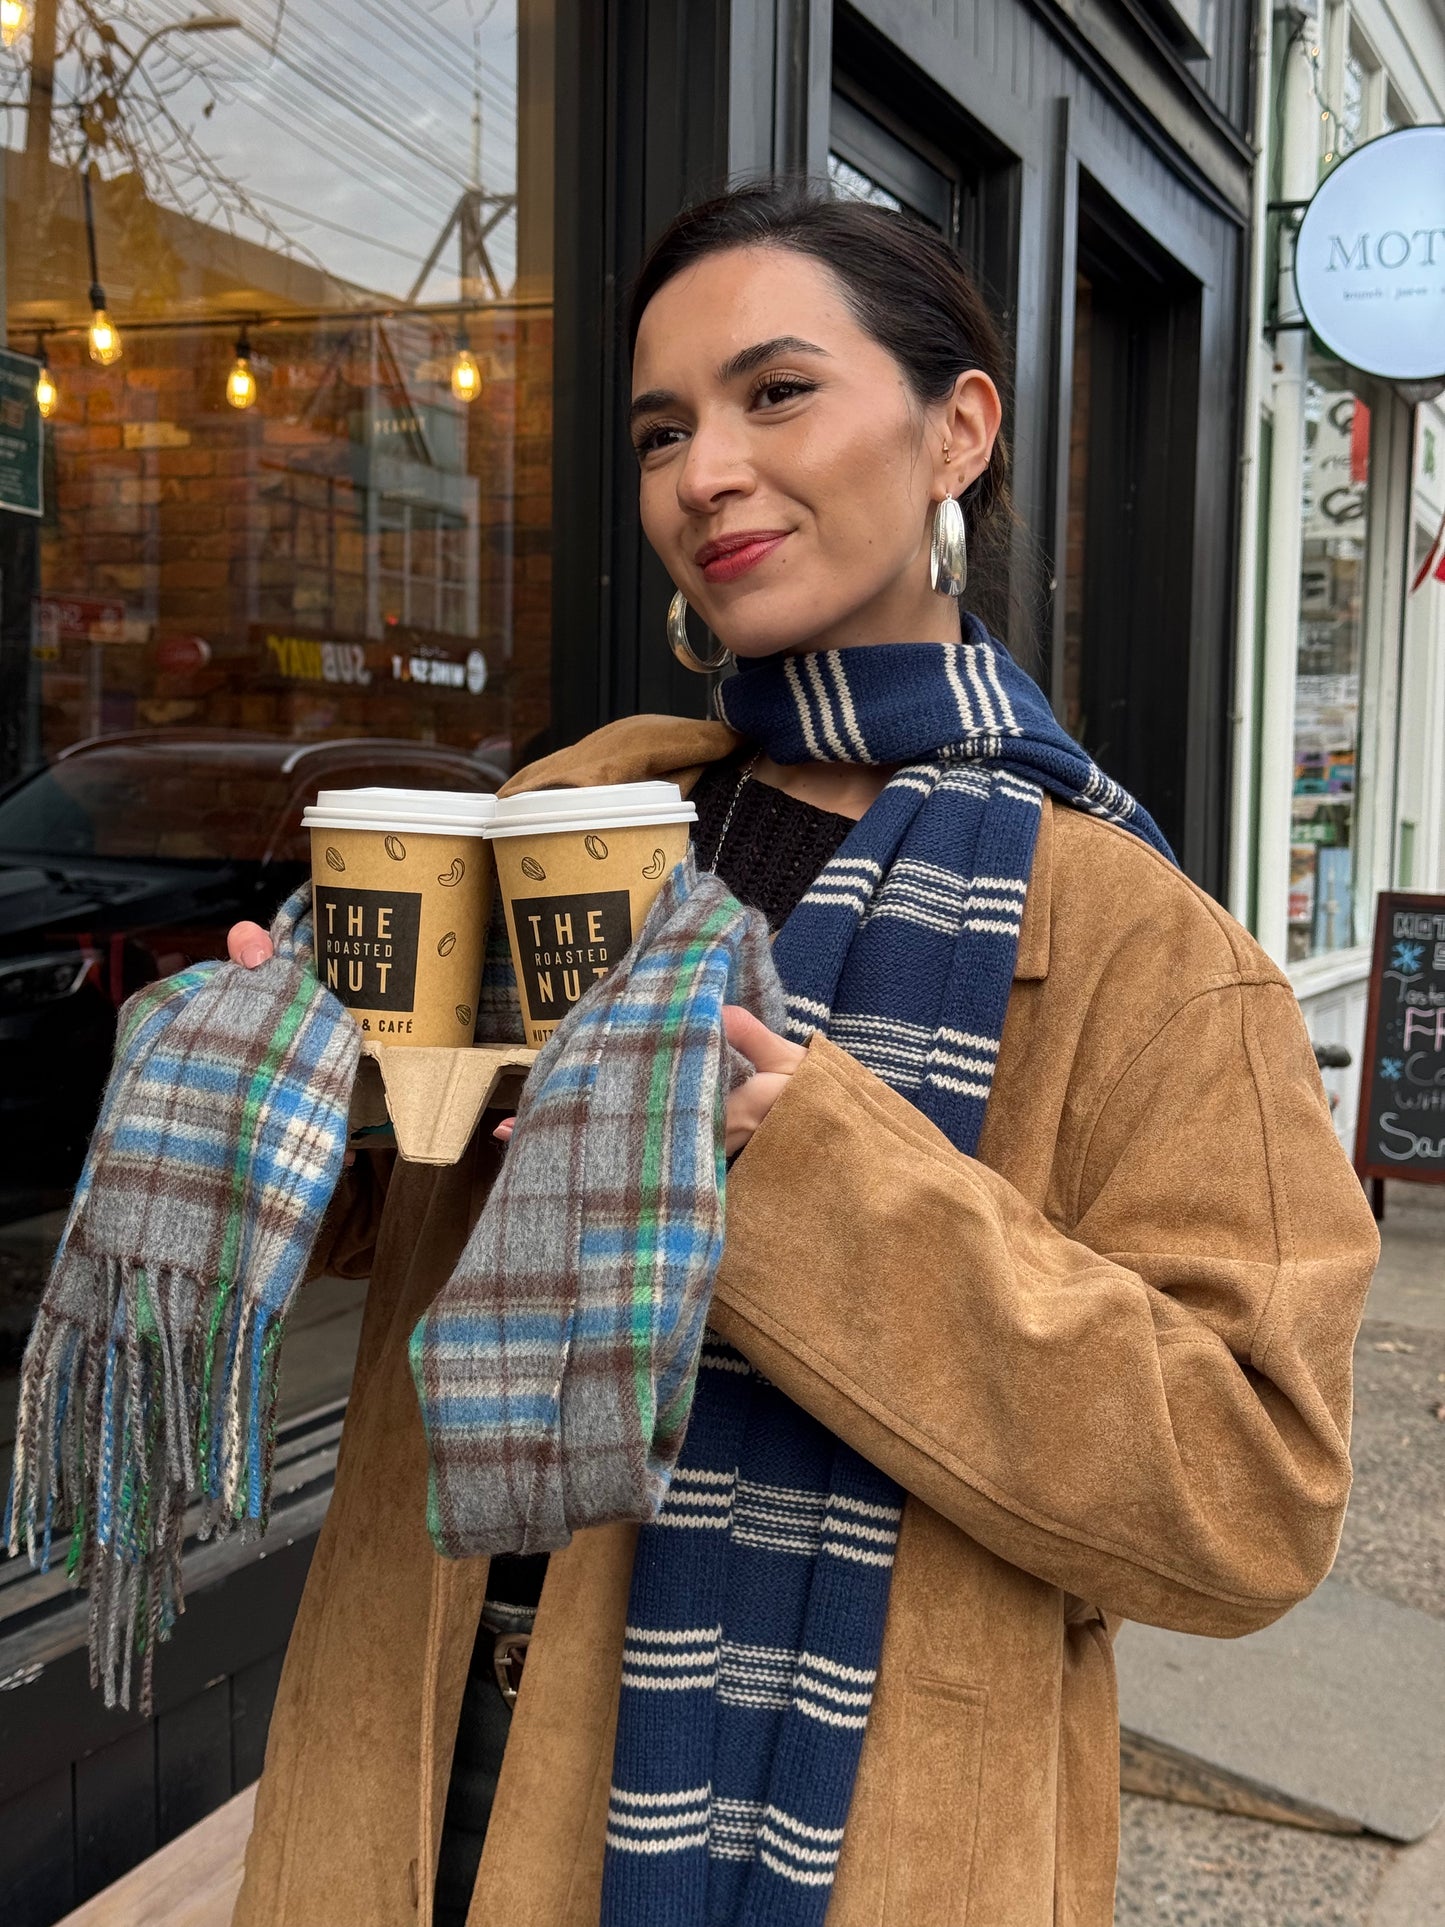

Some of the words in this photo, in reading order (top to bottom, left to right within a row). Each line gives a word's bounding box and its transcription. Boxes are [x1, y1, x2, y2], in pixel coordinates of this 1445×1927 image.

[1325, 228, 1445, 271] MOT
[326, 904, 393, 939] THE
[528, 911, 605, 946] THE
[327, 940, 392, 957] ROASTED
[535, 948, 607, 966] ROASTED
[327, 958, 392, 993] NUT
[362, 1018, 371, 1031] &
[378, 1018, 413, 1033] CAFÉ
